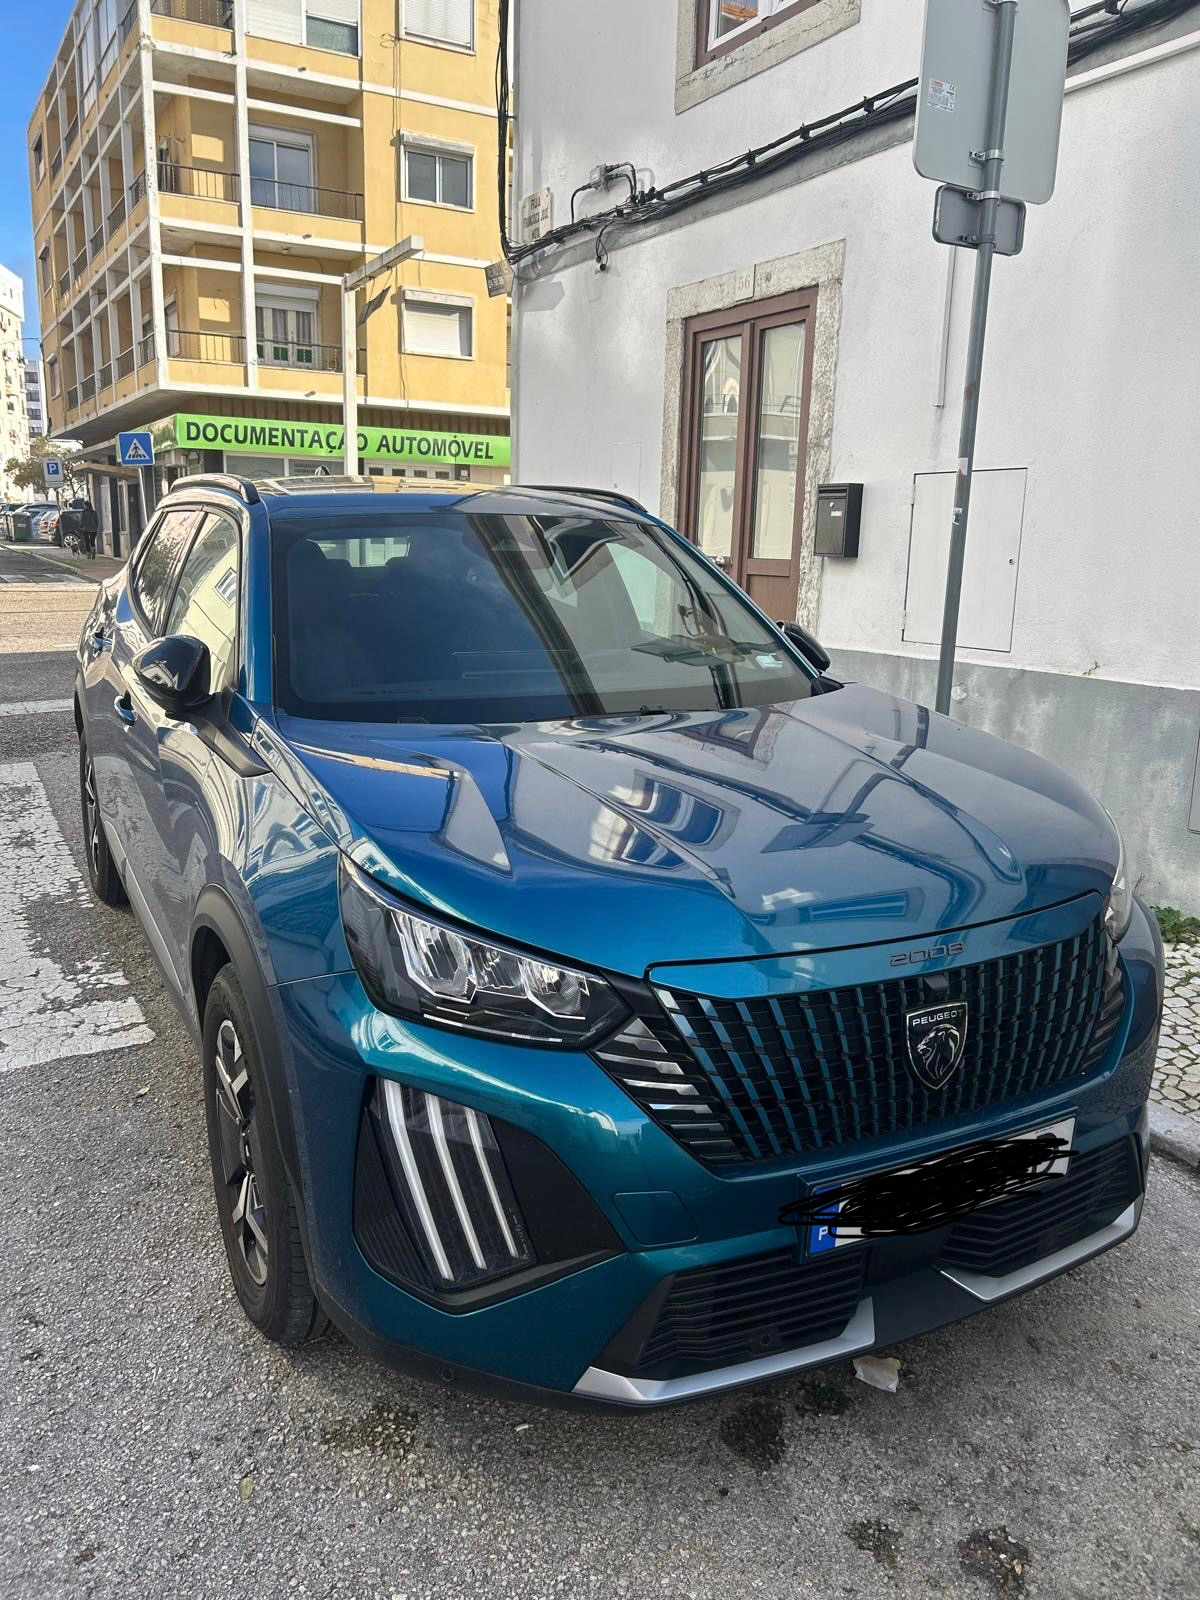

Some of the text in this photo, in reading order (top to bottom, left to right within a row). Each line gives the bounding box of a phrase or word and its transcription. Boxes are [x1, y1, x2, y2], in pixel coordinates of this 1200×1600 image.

[186, 421, 494, 459] DOCUMENTAÇO AUTOMÓVEL
[48, 463, 56, 473] P
[888, 941, 964, 967] 2008
[912, 1008, 962, 1027] PEUGEOT
[818, 1227, 829, 1241] P
